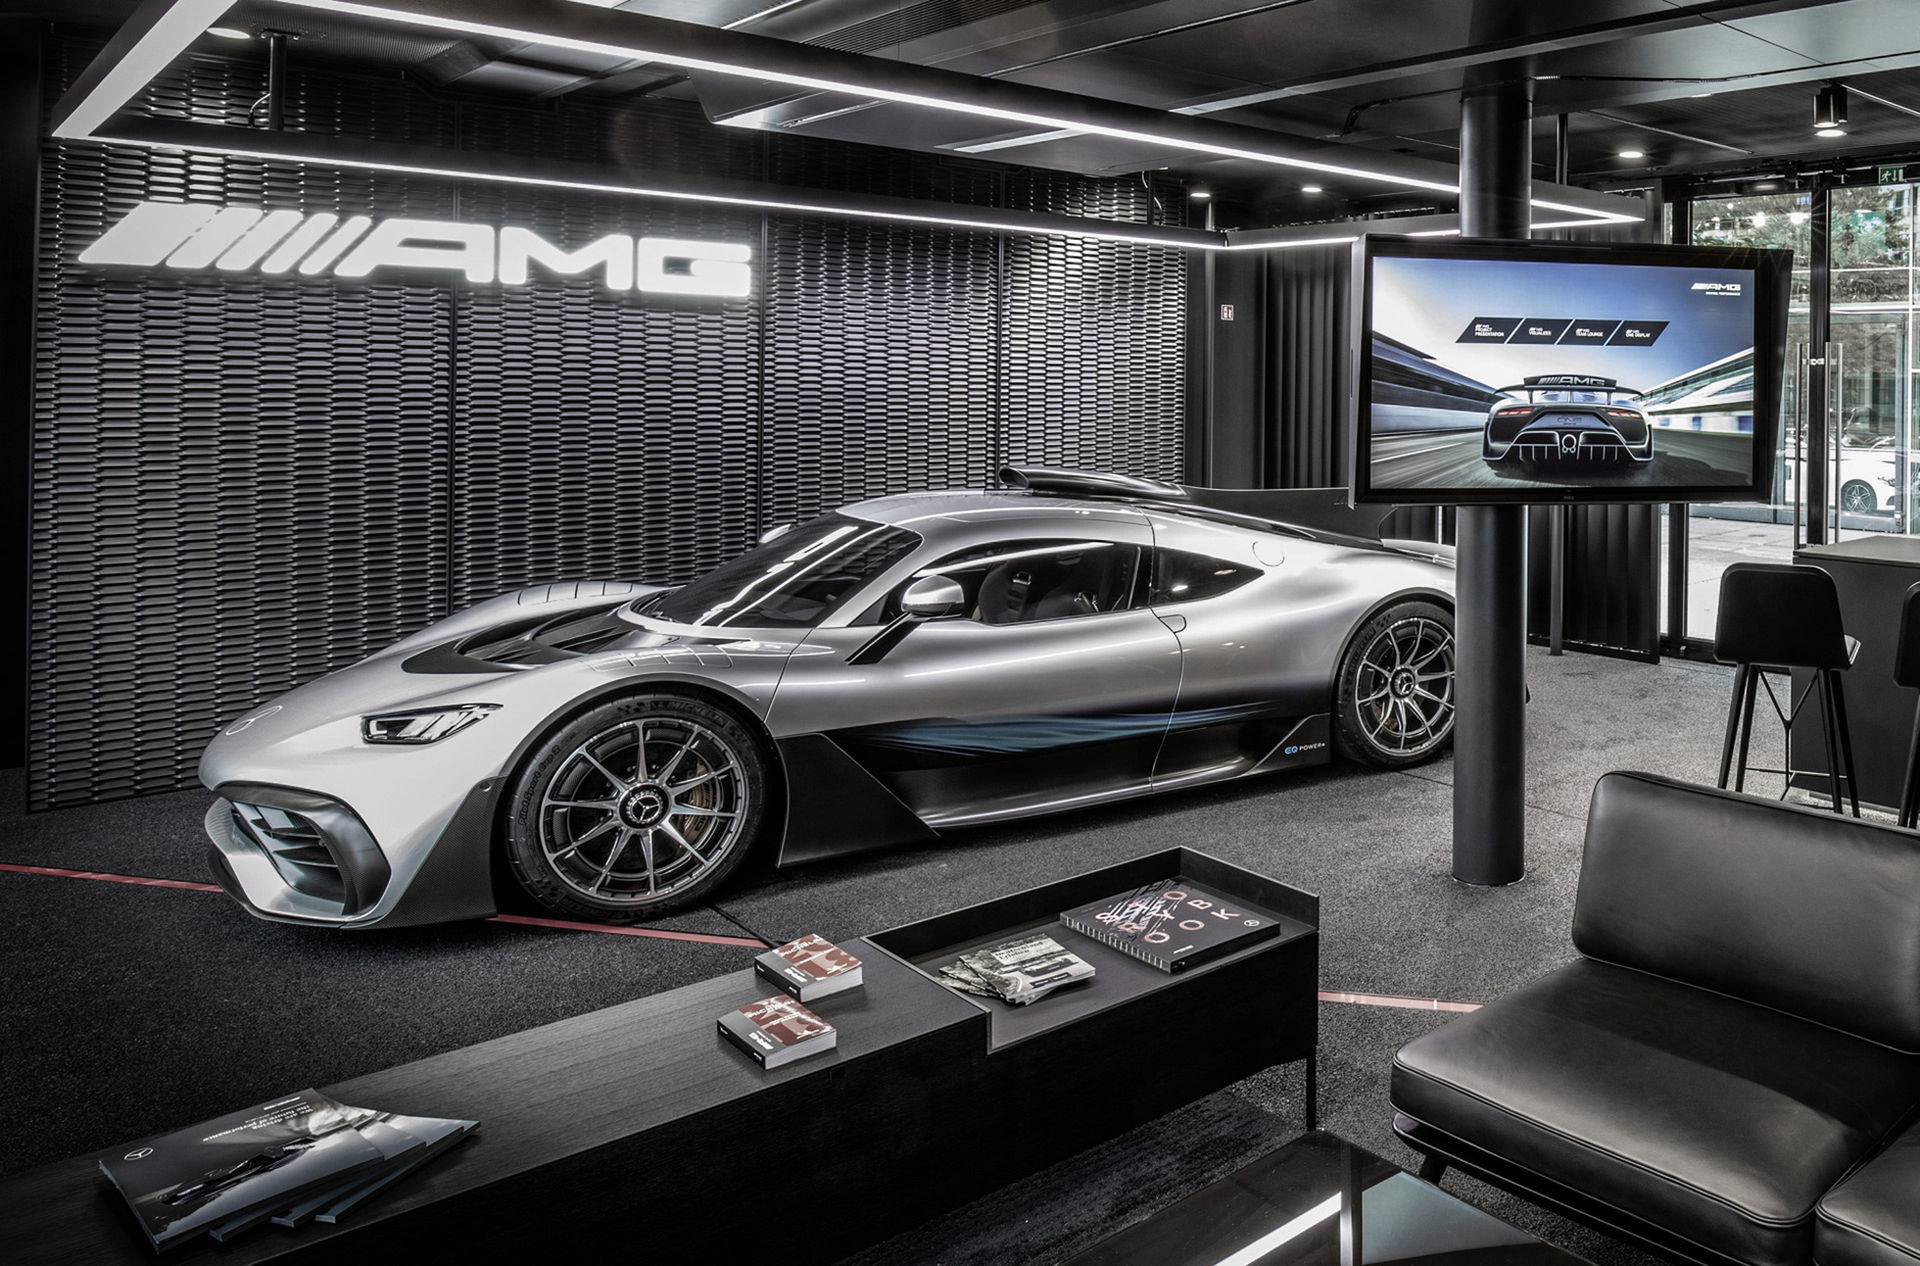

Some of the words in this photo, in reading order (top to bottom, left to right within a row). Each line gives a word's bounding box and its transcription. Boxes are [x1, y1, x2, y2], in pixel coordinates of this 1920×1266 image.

[334, 218, 752, 298] AMG
[1558, 376, 1605, 386] AMG
[1284, 746, 1298, 755] EQ
